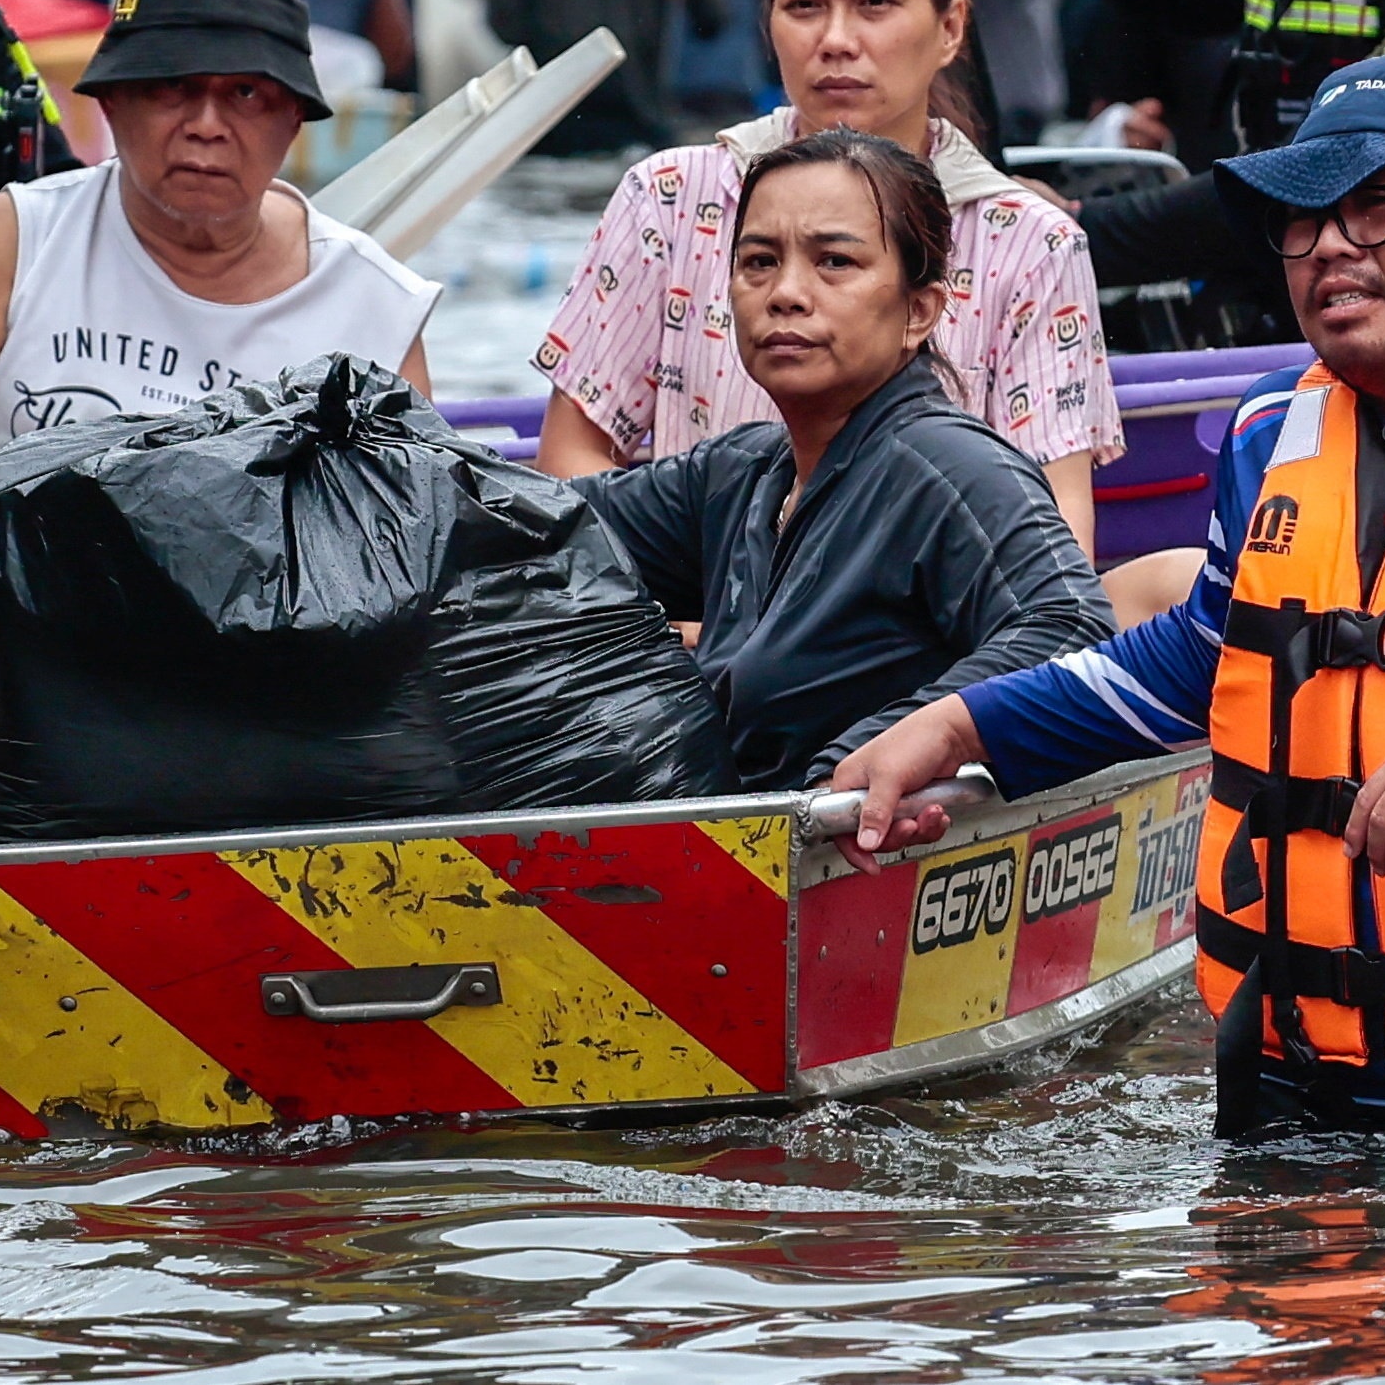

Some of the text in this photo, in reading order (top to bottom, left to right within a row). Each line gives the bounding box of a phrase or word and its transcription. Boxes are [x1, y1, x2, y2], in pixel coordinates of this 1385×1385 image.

[52, 326, 242, 392] UNITED ST
[917, 825, 1120, 944] 6670 00562
